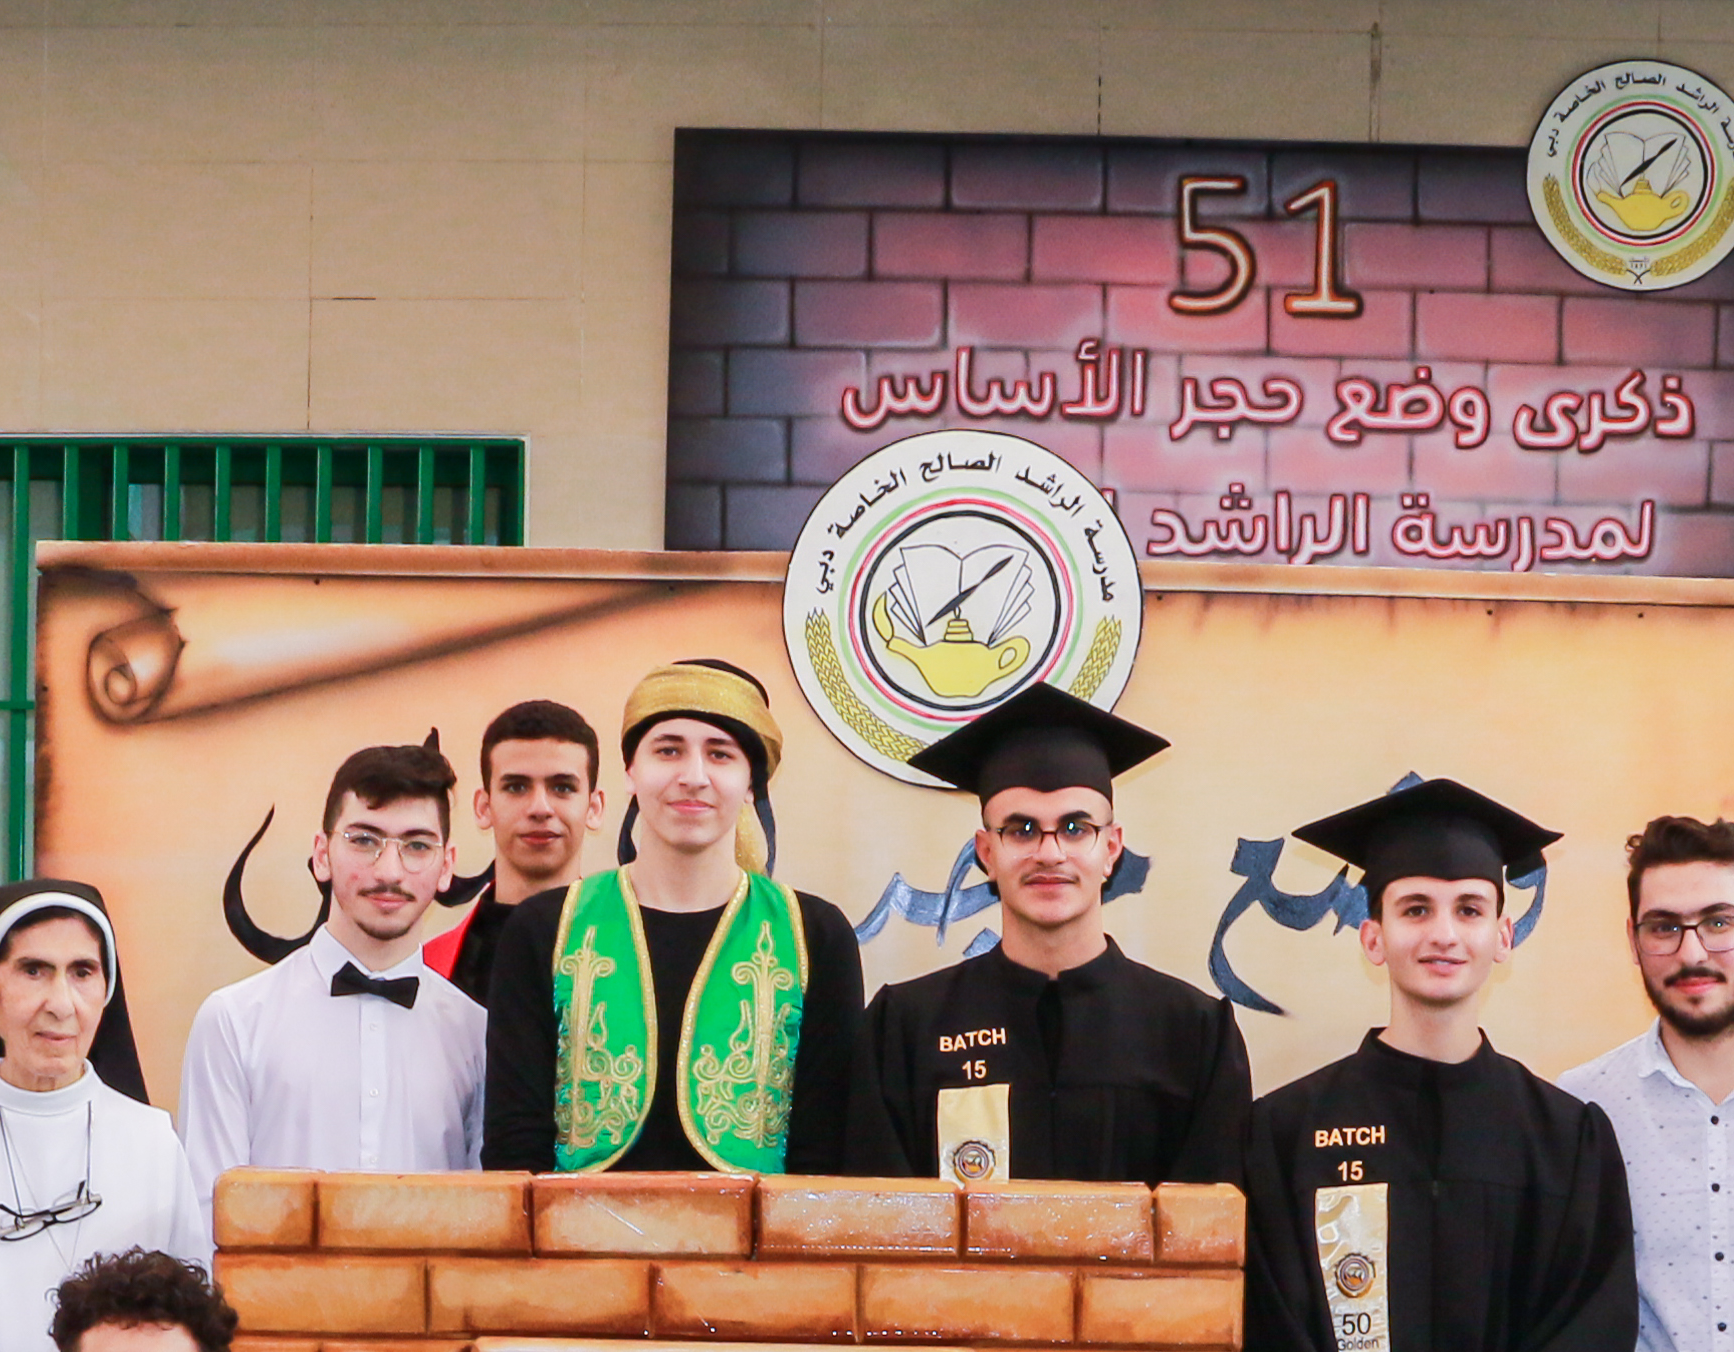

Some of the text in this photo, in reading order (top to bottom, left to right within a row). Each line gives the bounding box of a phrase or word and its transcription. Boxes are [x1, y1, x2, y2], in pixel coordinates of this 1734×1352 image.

[1614, 72, 1667, 90] الصالح
[1553, 78, 1607, 124] الخاصة
[1675, 82, 1720, 114] الراشد
[1546, 128, 1560, 158] دبي
[1169, 176, 1363, 318] 51
[841, 338, 1696, 453] ذكرى وضع حجر الأساس
[919, 449, 1003, 482] الصالح
[827, 466, 908, 539] الخاصة
[1014, 465, 1086, 516] الراشد
[1146, 481, 1657, 573] لمدرسة الراشد
[815, 549, 835, 594] دبي
[1084, 518, 1114, 602] مدرسة
[939, 1027, 1007, 1053] BATCH
[961, 1060, 987, 1080] 15
[1314, 1125, 1386, 1148] BATCH
[1337, 1160, 1364, 1181] 15
[1342, 1312, 1372, 1336] 50
[1337, 1337, 1380, 1352] Golden
